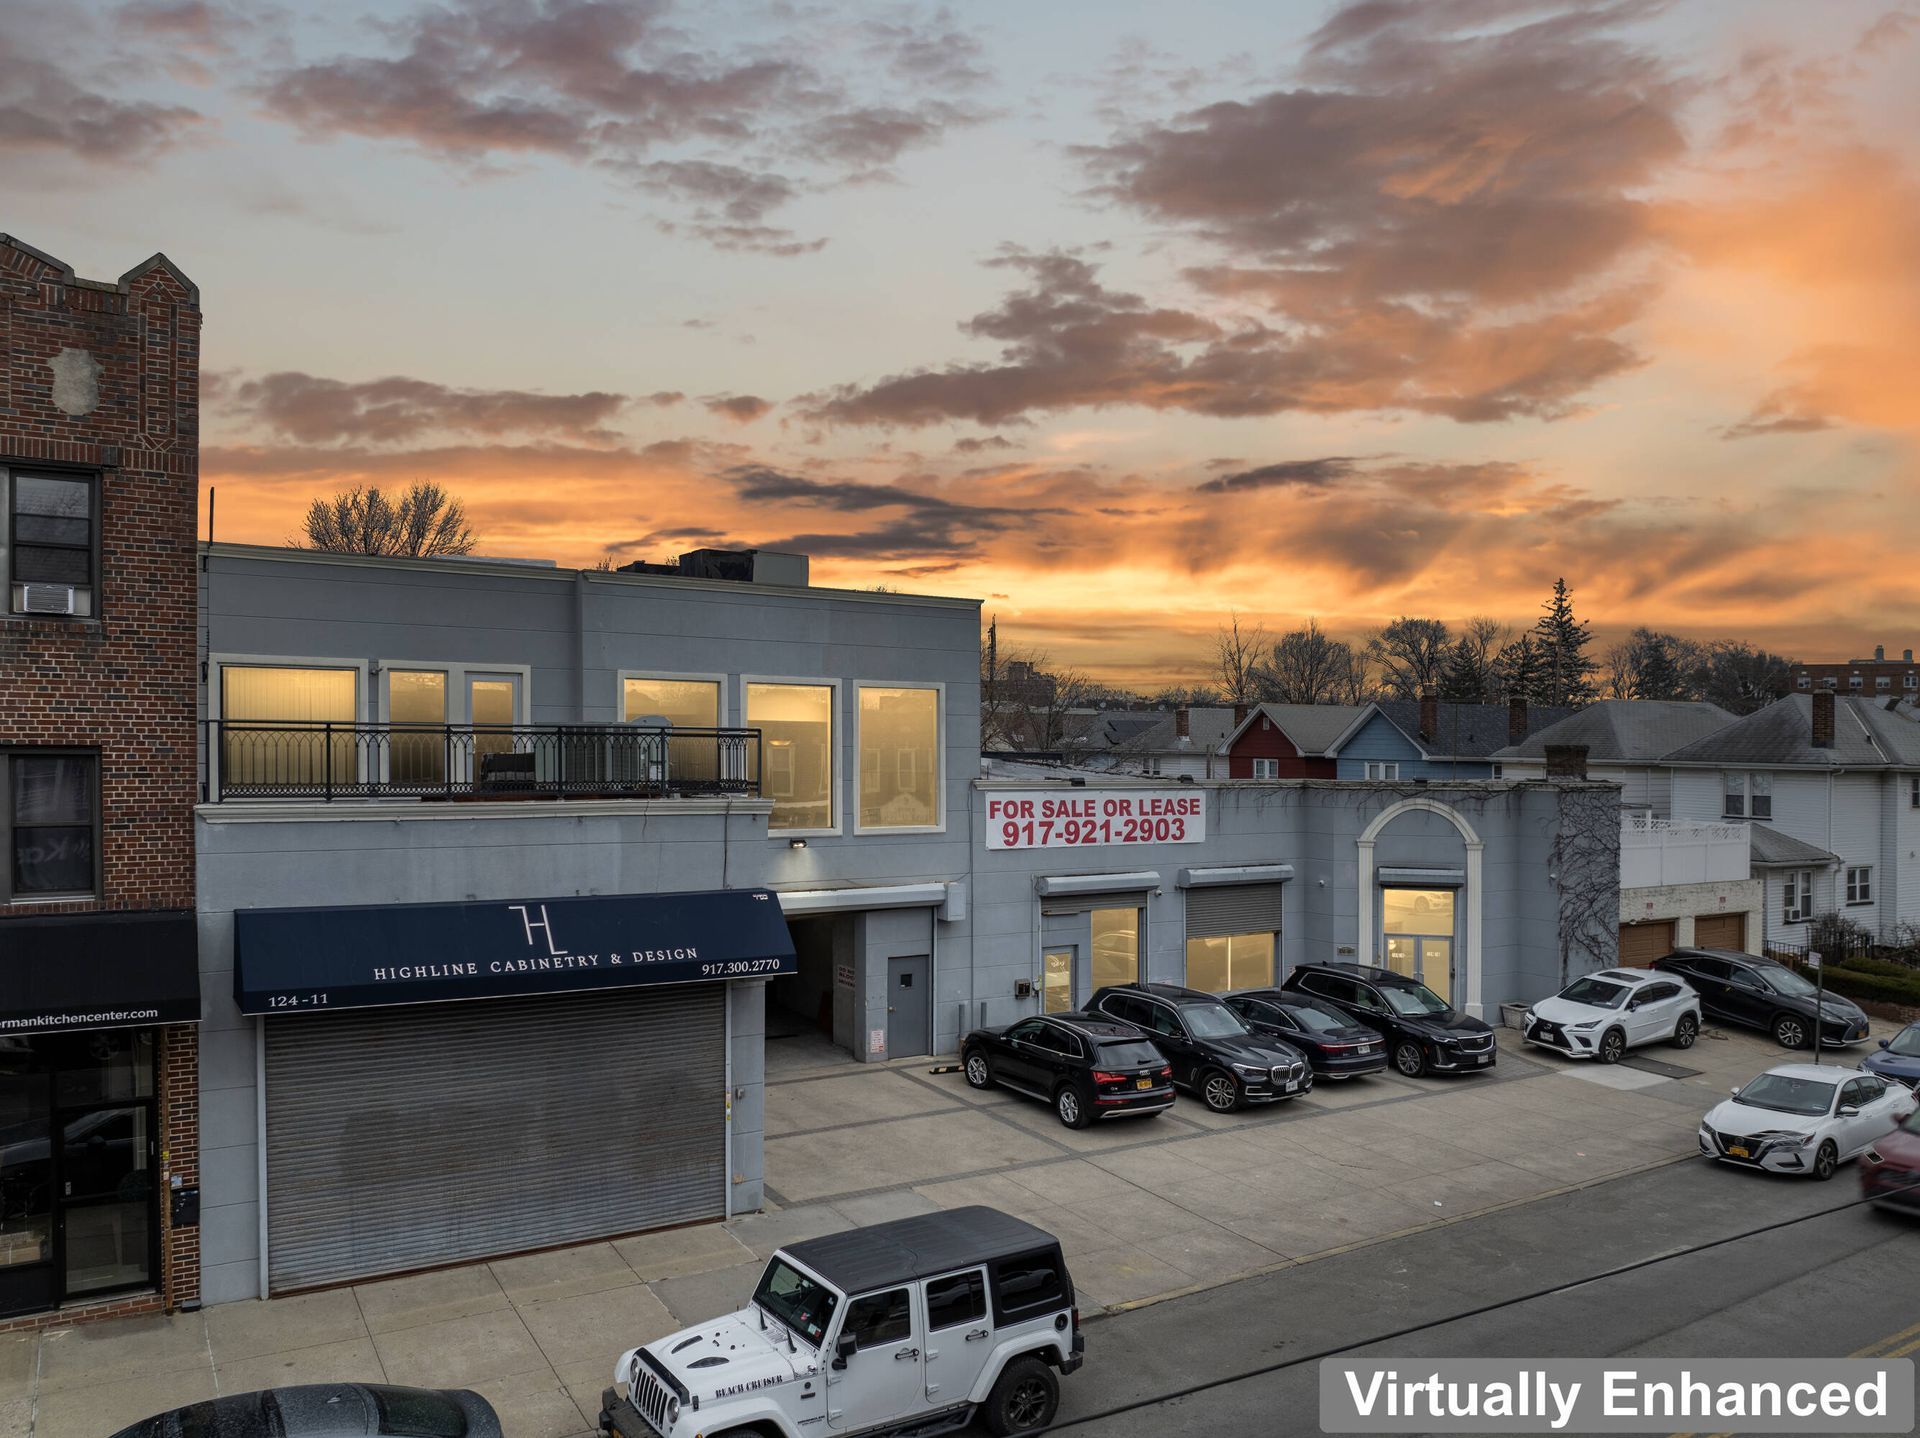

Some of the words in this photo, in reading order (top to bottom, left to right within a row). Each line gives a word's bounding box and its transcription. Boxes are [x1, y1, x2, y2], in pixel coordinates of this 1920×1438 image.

[990, 800, 1035, 819] FOR
[1042, 799, 1096, 819] SALE
[1103, 799, 1132, 817] OR
[1139, 798, 1201, 816] LEASE
[1002, 818, 1185, 847] 917-921-2903
[374, 962, 478, 980] HIGHLINE
[490, 954, 599, 973] CABINETRY
[610, 953, 622, 964] &
[632, 948, 698, 963] DESIGN
[702, 958, 780, 976] 917.300.2770
[268, 993, 328, 1007] 124-11
[746, 1374, 783, 1392] CRUISER
